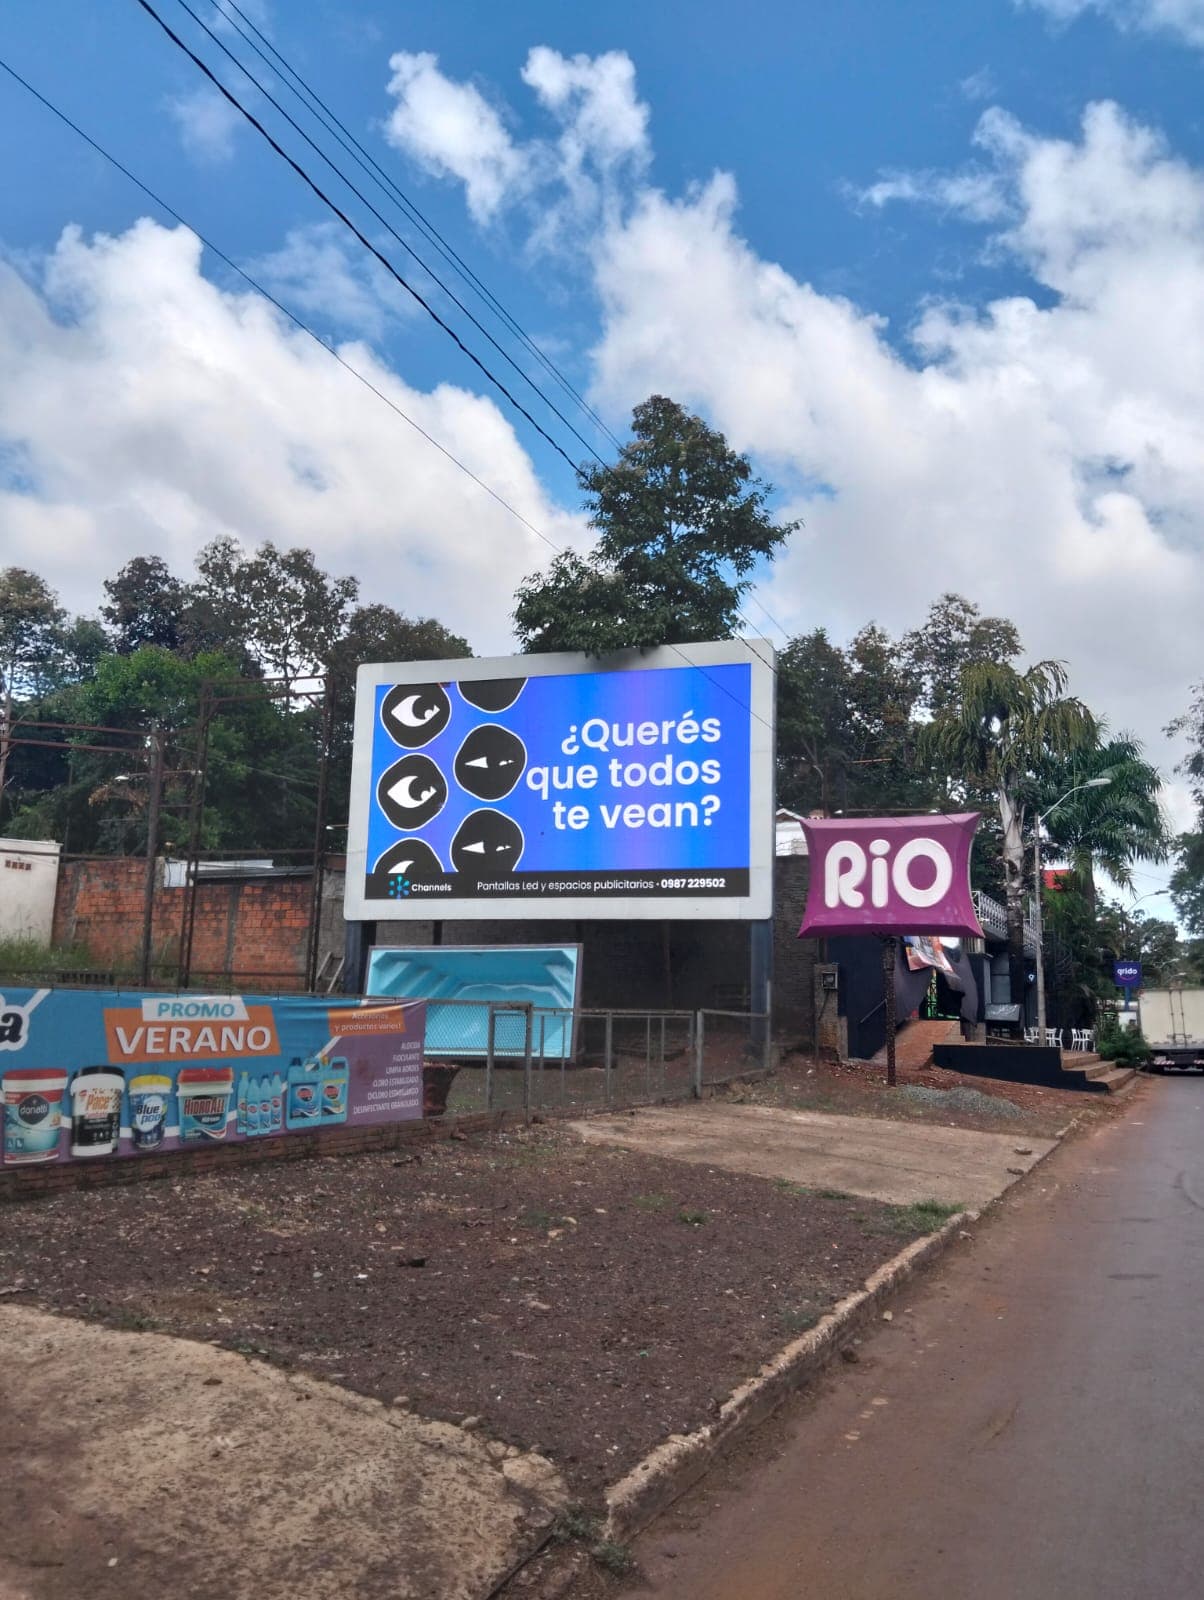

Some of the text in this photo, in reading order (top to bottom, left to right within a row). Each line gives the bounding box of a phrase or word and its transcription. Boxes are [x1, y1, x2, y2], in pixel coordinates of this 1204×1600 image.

[561, 709, 721, 755] ¿Querés
[526, 754, 721, 800] que todos
[553, 794, 721, 830] te vean?
[411, 883, 452, 892] Channels
[477, 878, 726, 892] Pantallas Led y espacios publicitarios 0987 229502
[157, 1003, 235, 1018] PROMO
[115, 1026, 272, 1055] VERANO
[136, 1104, 160, 1114] Blue
